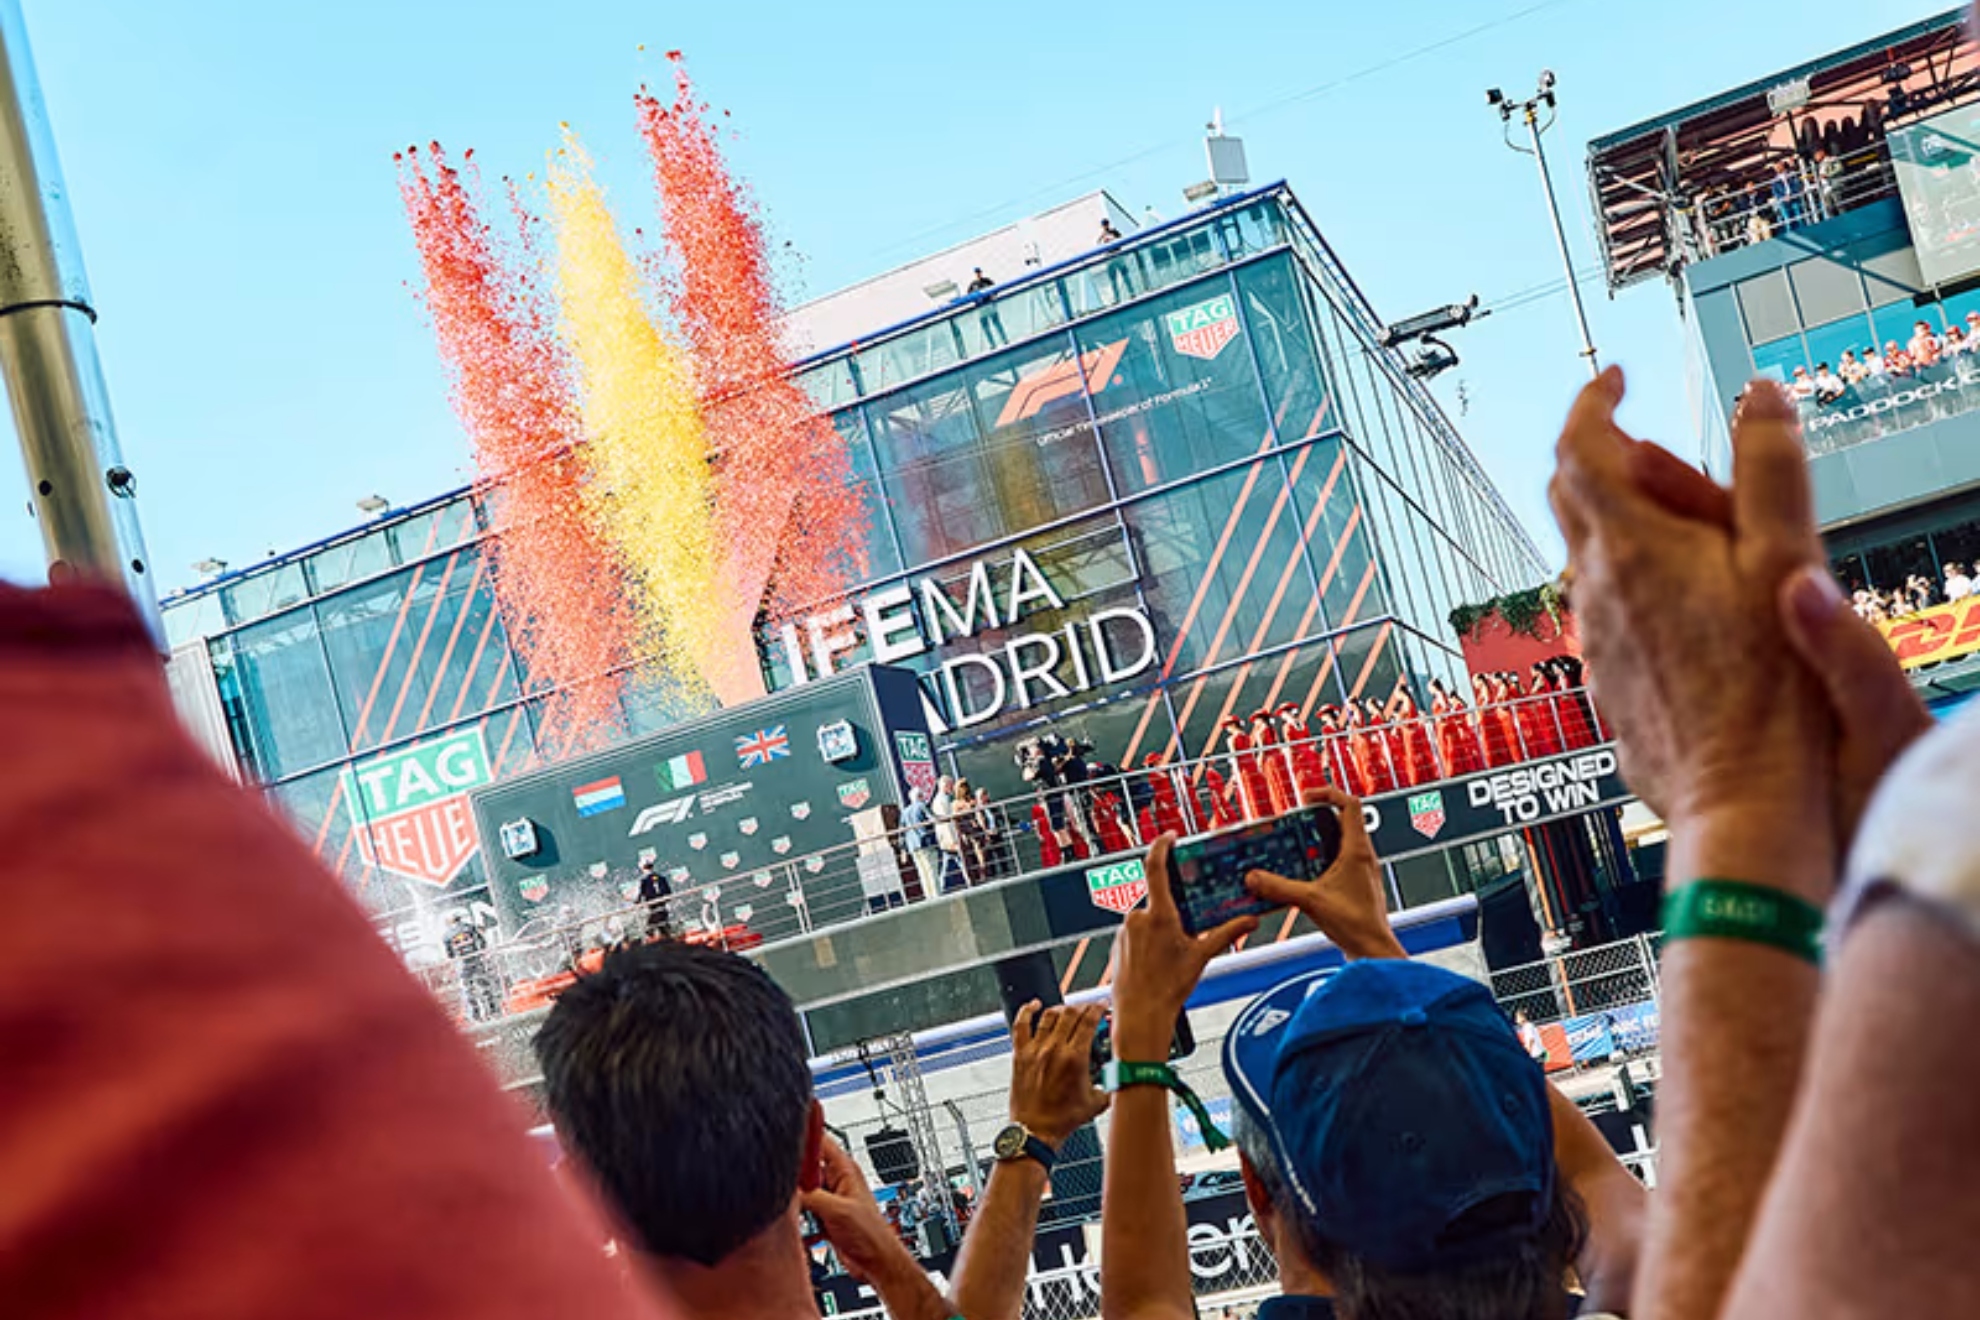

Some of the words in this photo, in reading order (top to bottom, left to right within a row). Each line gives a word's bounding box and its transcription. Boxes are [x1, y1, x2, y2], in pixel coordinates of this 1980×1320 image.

[1170, 302, 1229, 331] TAG
[1809, 376, 1957, 432] PADDOCK
[782, 547, 1064, 684] IFEMA
[919, 607, 1156, 734] DRID
[898, 737, 928, 758] TAG
[358, 742, 477, 811] TAG
[1467, 751, 1617, 807] DESIGNED
[1496, 794, 1540, 825] TO
[1543, 779, 1599, 813] WIN
[357, 801, 471, 878] HEUE
[1090, 862, 1140, 887] TAG
